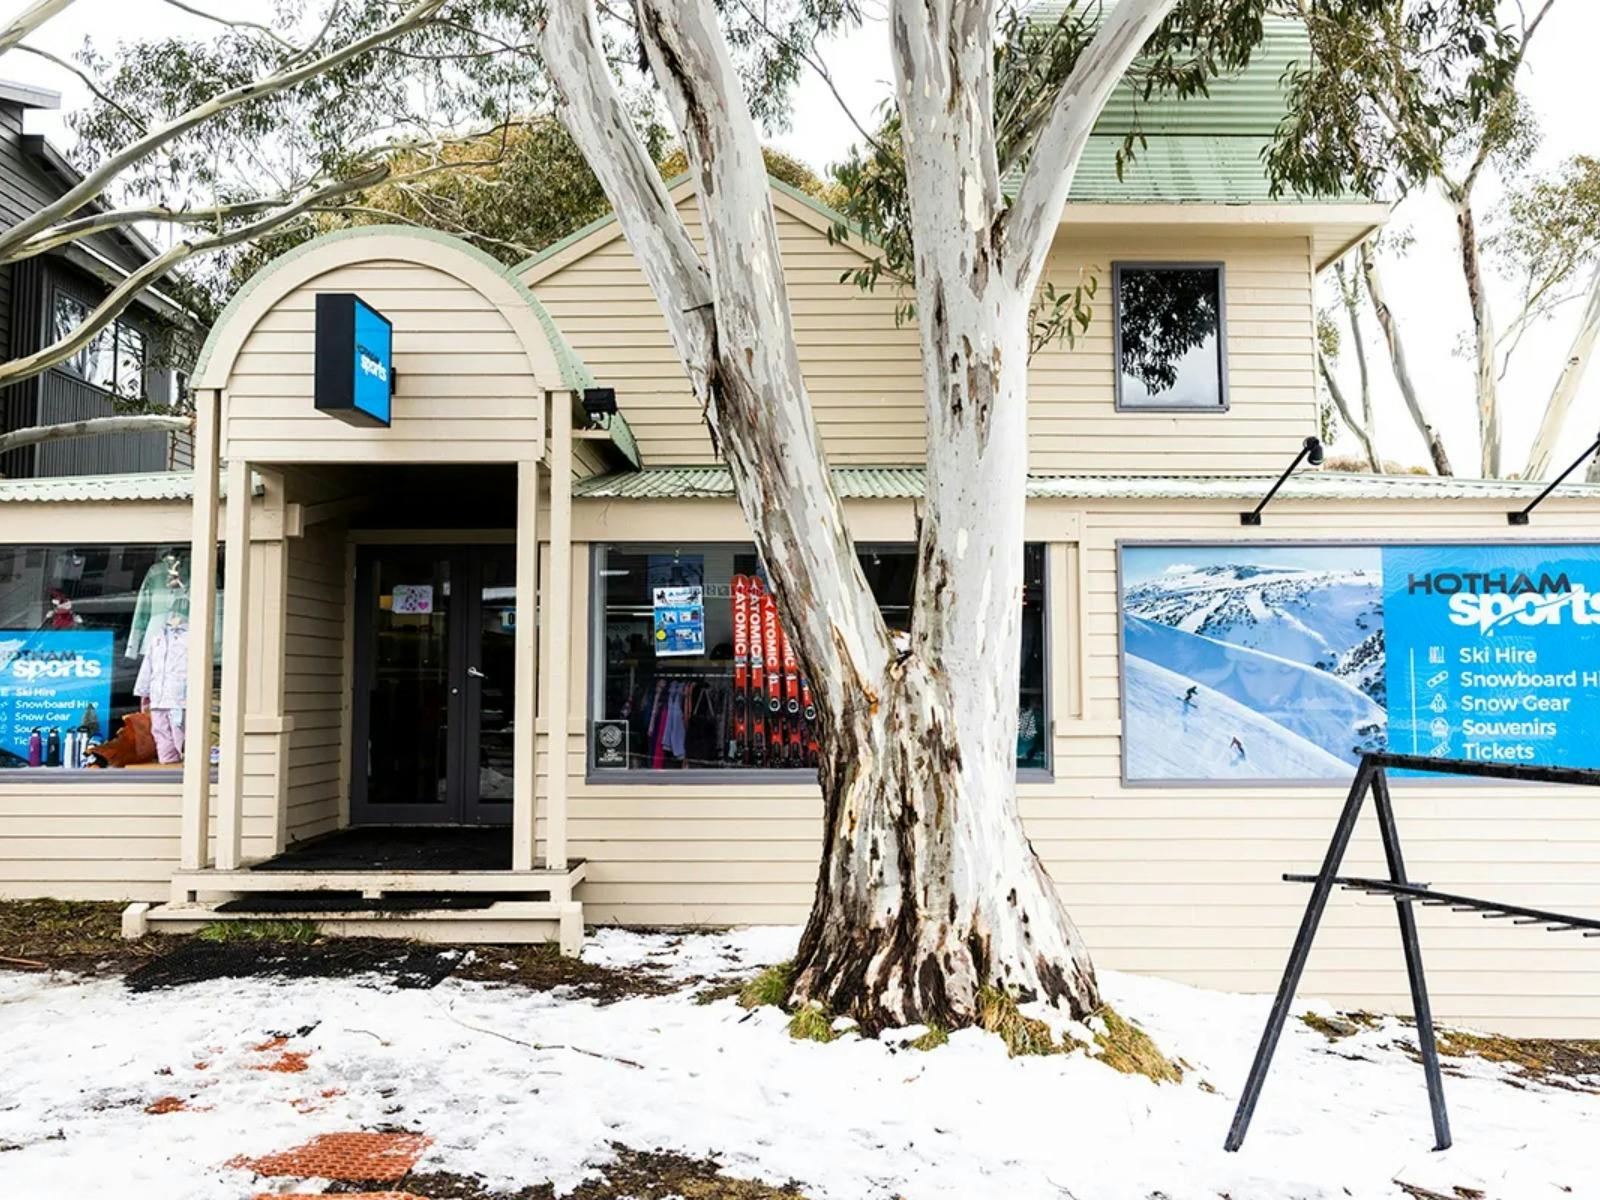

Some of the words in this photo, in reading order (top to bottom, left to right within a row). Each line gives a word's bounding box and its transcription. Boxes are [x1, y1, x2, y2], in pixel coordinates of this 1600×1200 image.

[1408, 573, 1571, 595] HOTHAM
[735, 592, 747, 656] ATOMIC
[750, 594, 762, 658] ATOMIC
[765, 611, 777, 667] ATOMIC
[1459, 646, 1490, 664] Ski
[1495, 646, 1537, 664] Hire
[12, 655, 101, 683] sports
[1460, 670, 1577, 687] Snowboard
[15, 700, 75, 709] Snowboard
[77, 701, 99, 709] Hie
[1461, 695, 1518, 711] Snow
[1522, 695, 1571, 711] Gear
[15, 712, 44, 721] Snow
[46, 712, 71, 721] Gear
[1462, 718, 1557, 735] Souvenirs
[1462, 742, 1535, 759] Tickets
